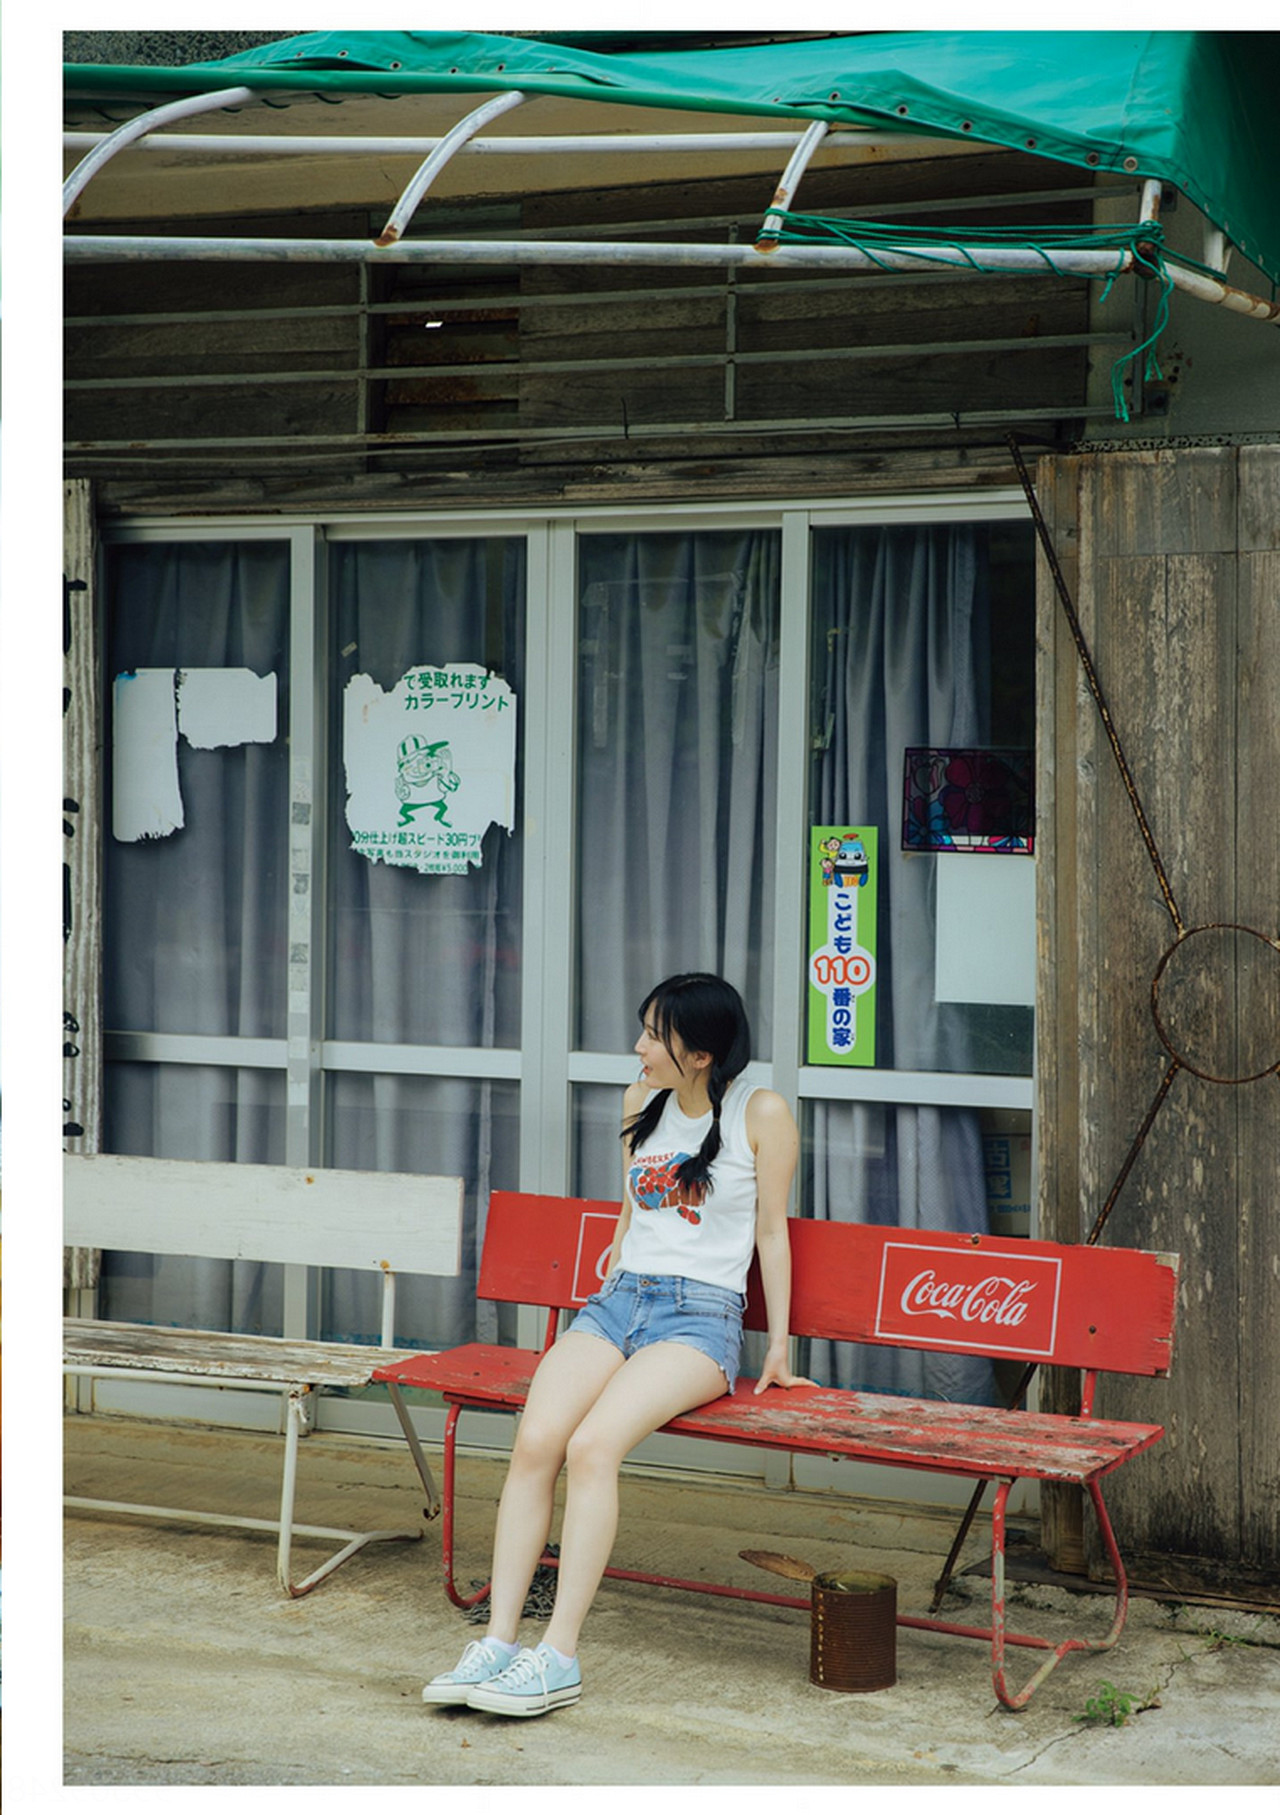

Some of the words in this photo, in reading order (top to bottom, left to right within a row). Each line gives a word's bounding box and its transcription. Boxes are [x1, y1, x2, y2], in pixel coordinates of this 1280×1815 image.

[403, 671, 490, 690] て受取れます
[404, 692, 509, 711] カラープリント
[901, 1269, 1038, 1327] Coca-Cola
